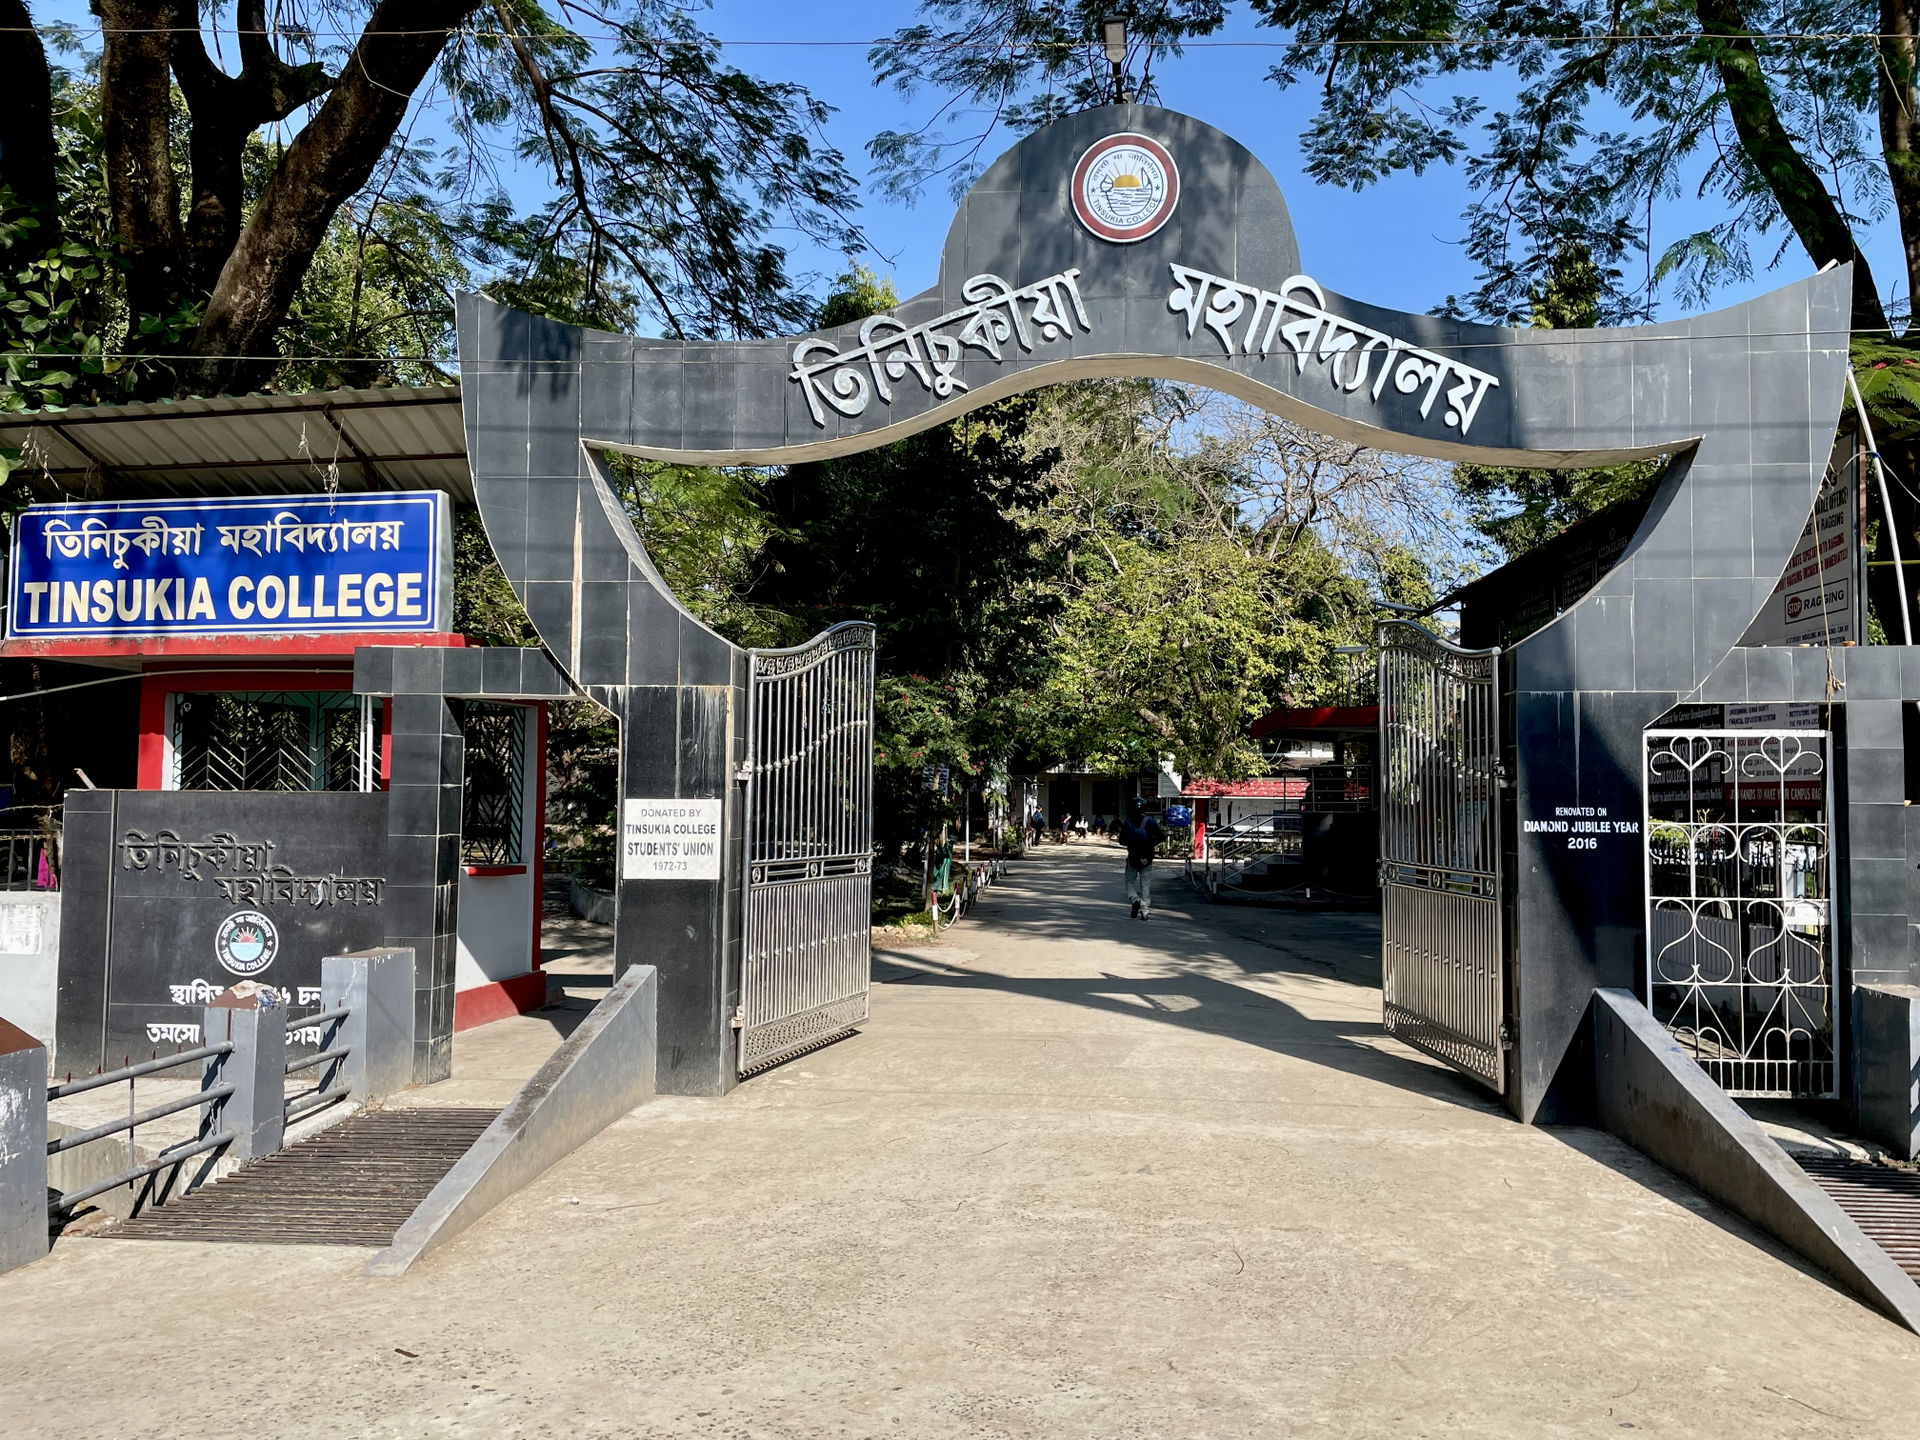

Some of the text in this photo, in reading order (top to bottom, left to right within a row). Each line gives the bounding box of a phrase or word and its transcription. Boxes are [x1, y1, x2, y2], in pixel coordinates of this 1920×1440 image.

[1093, 197, 1159, 225] TINSUKIA COLLEGE
[788, 262, 1500, 437] তিনিচুকীয়া মহাবিদ্যালয়
[43, 512, 404, 569] তিনিচুকীয়া মহাবিদ্যালয়
[24, 572, 422, 623] TINSUKIA COLLEGE
[1788, 590, 1845, 614] STOP RAGGING
[641, 808, 702, 817] DONATED BY
[1555, 807, 1607, 816] RENOVATED ON
[626, 824, 716, 834] TINSUKIA COLLEGE
[1523, 820, 1639, 833] DIAMOND JUBILEE YEAR
[627, 842, 714, 856] STUDENTS' UNION
[1567, 837, 1598, 849] 2016
[118, 829, 275, 881] তিনিচুকীয়া
[653, 861, 688, 871] 1972-73
[214, 864, 386, 908] মহাবিদ্যালয়
[221, 947, 272, 971] TINSUKIA COLLEGE
[146, 1023, 200, 1044] তমসো
